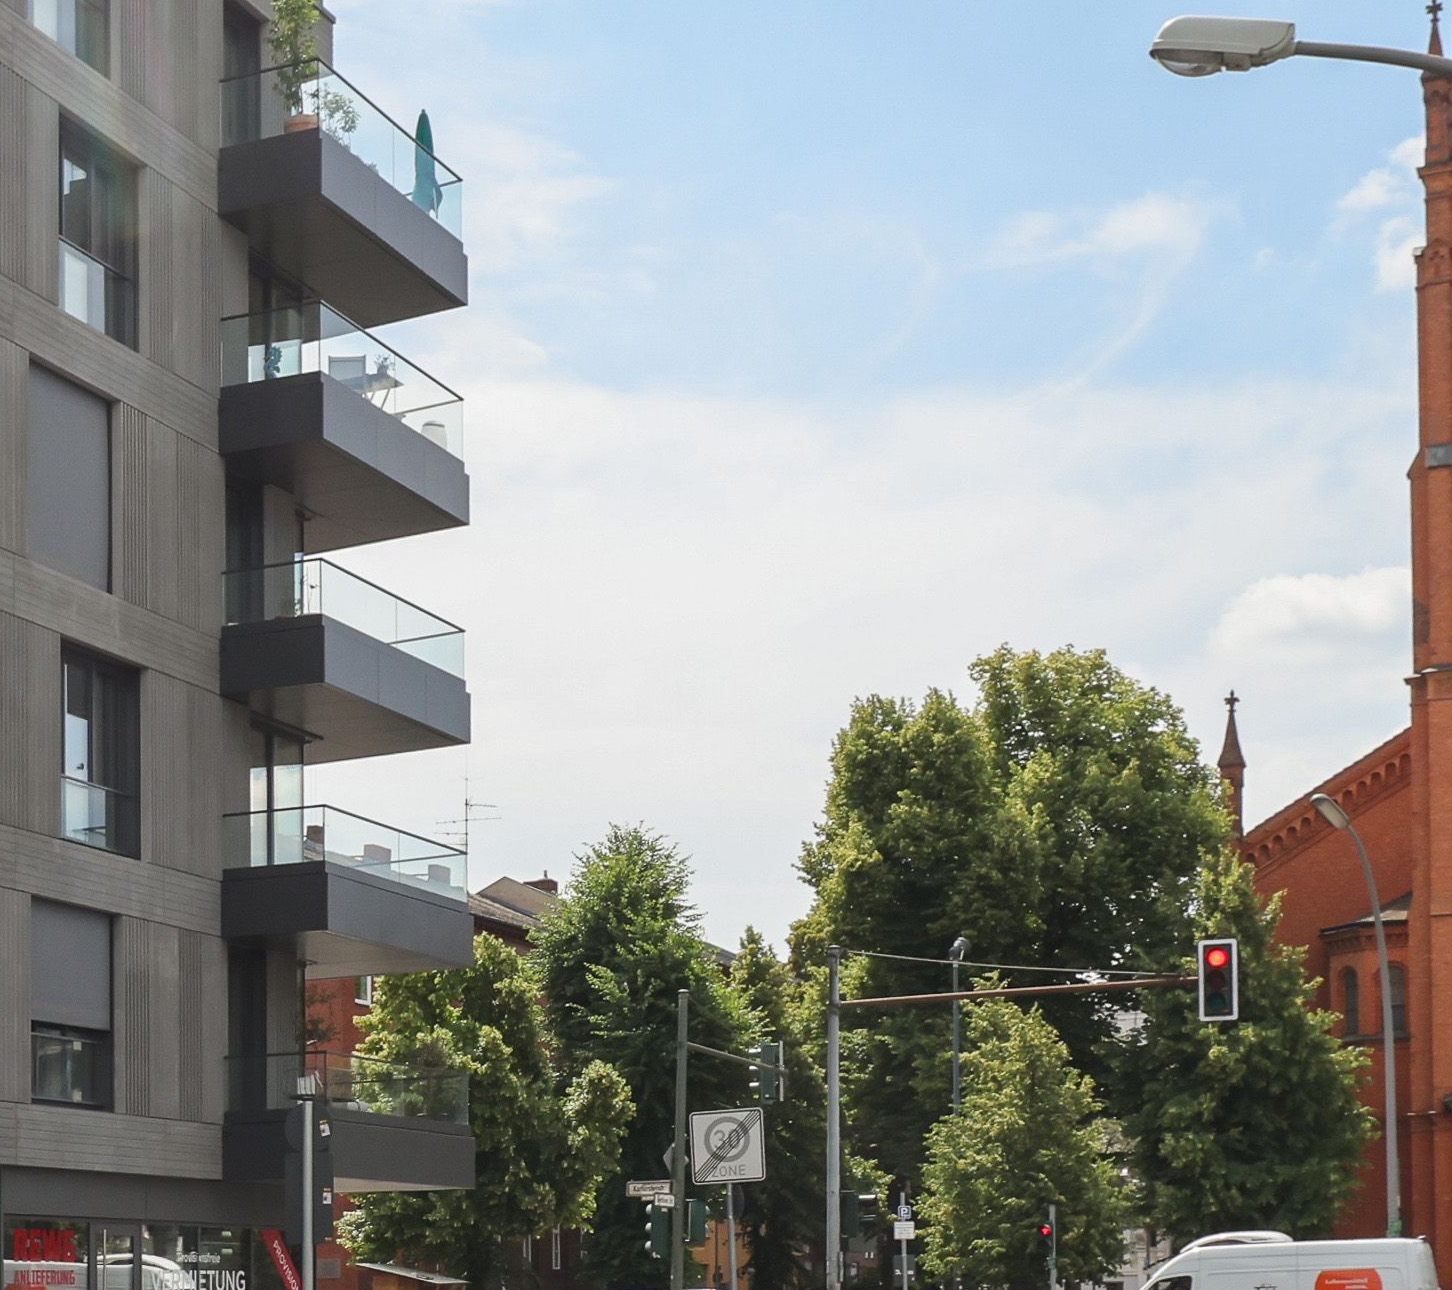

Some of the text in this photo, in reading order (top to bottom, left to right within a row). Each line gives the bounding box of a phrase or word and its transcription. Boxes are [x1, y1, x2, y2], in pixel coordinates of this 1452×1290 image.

[712, 1164, 746, 1178] ZONE
[13, 1228, 77, 1262] REWE
[13, 1269, 76, 1285] ANLIEFERUNG
